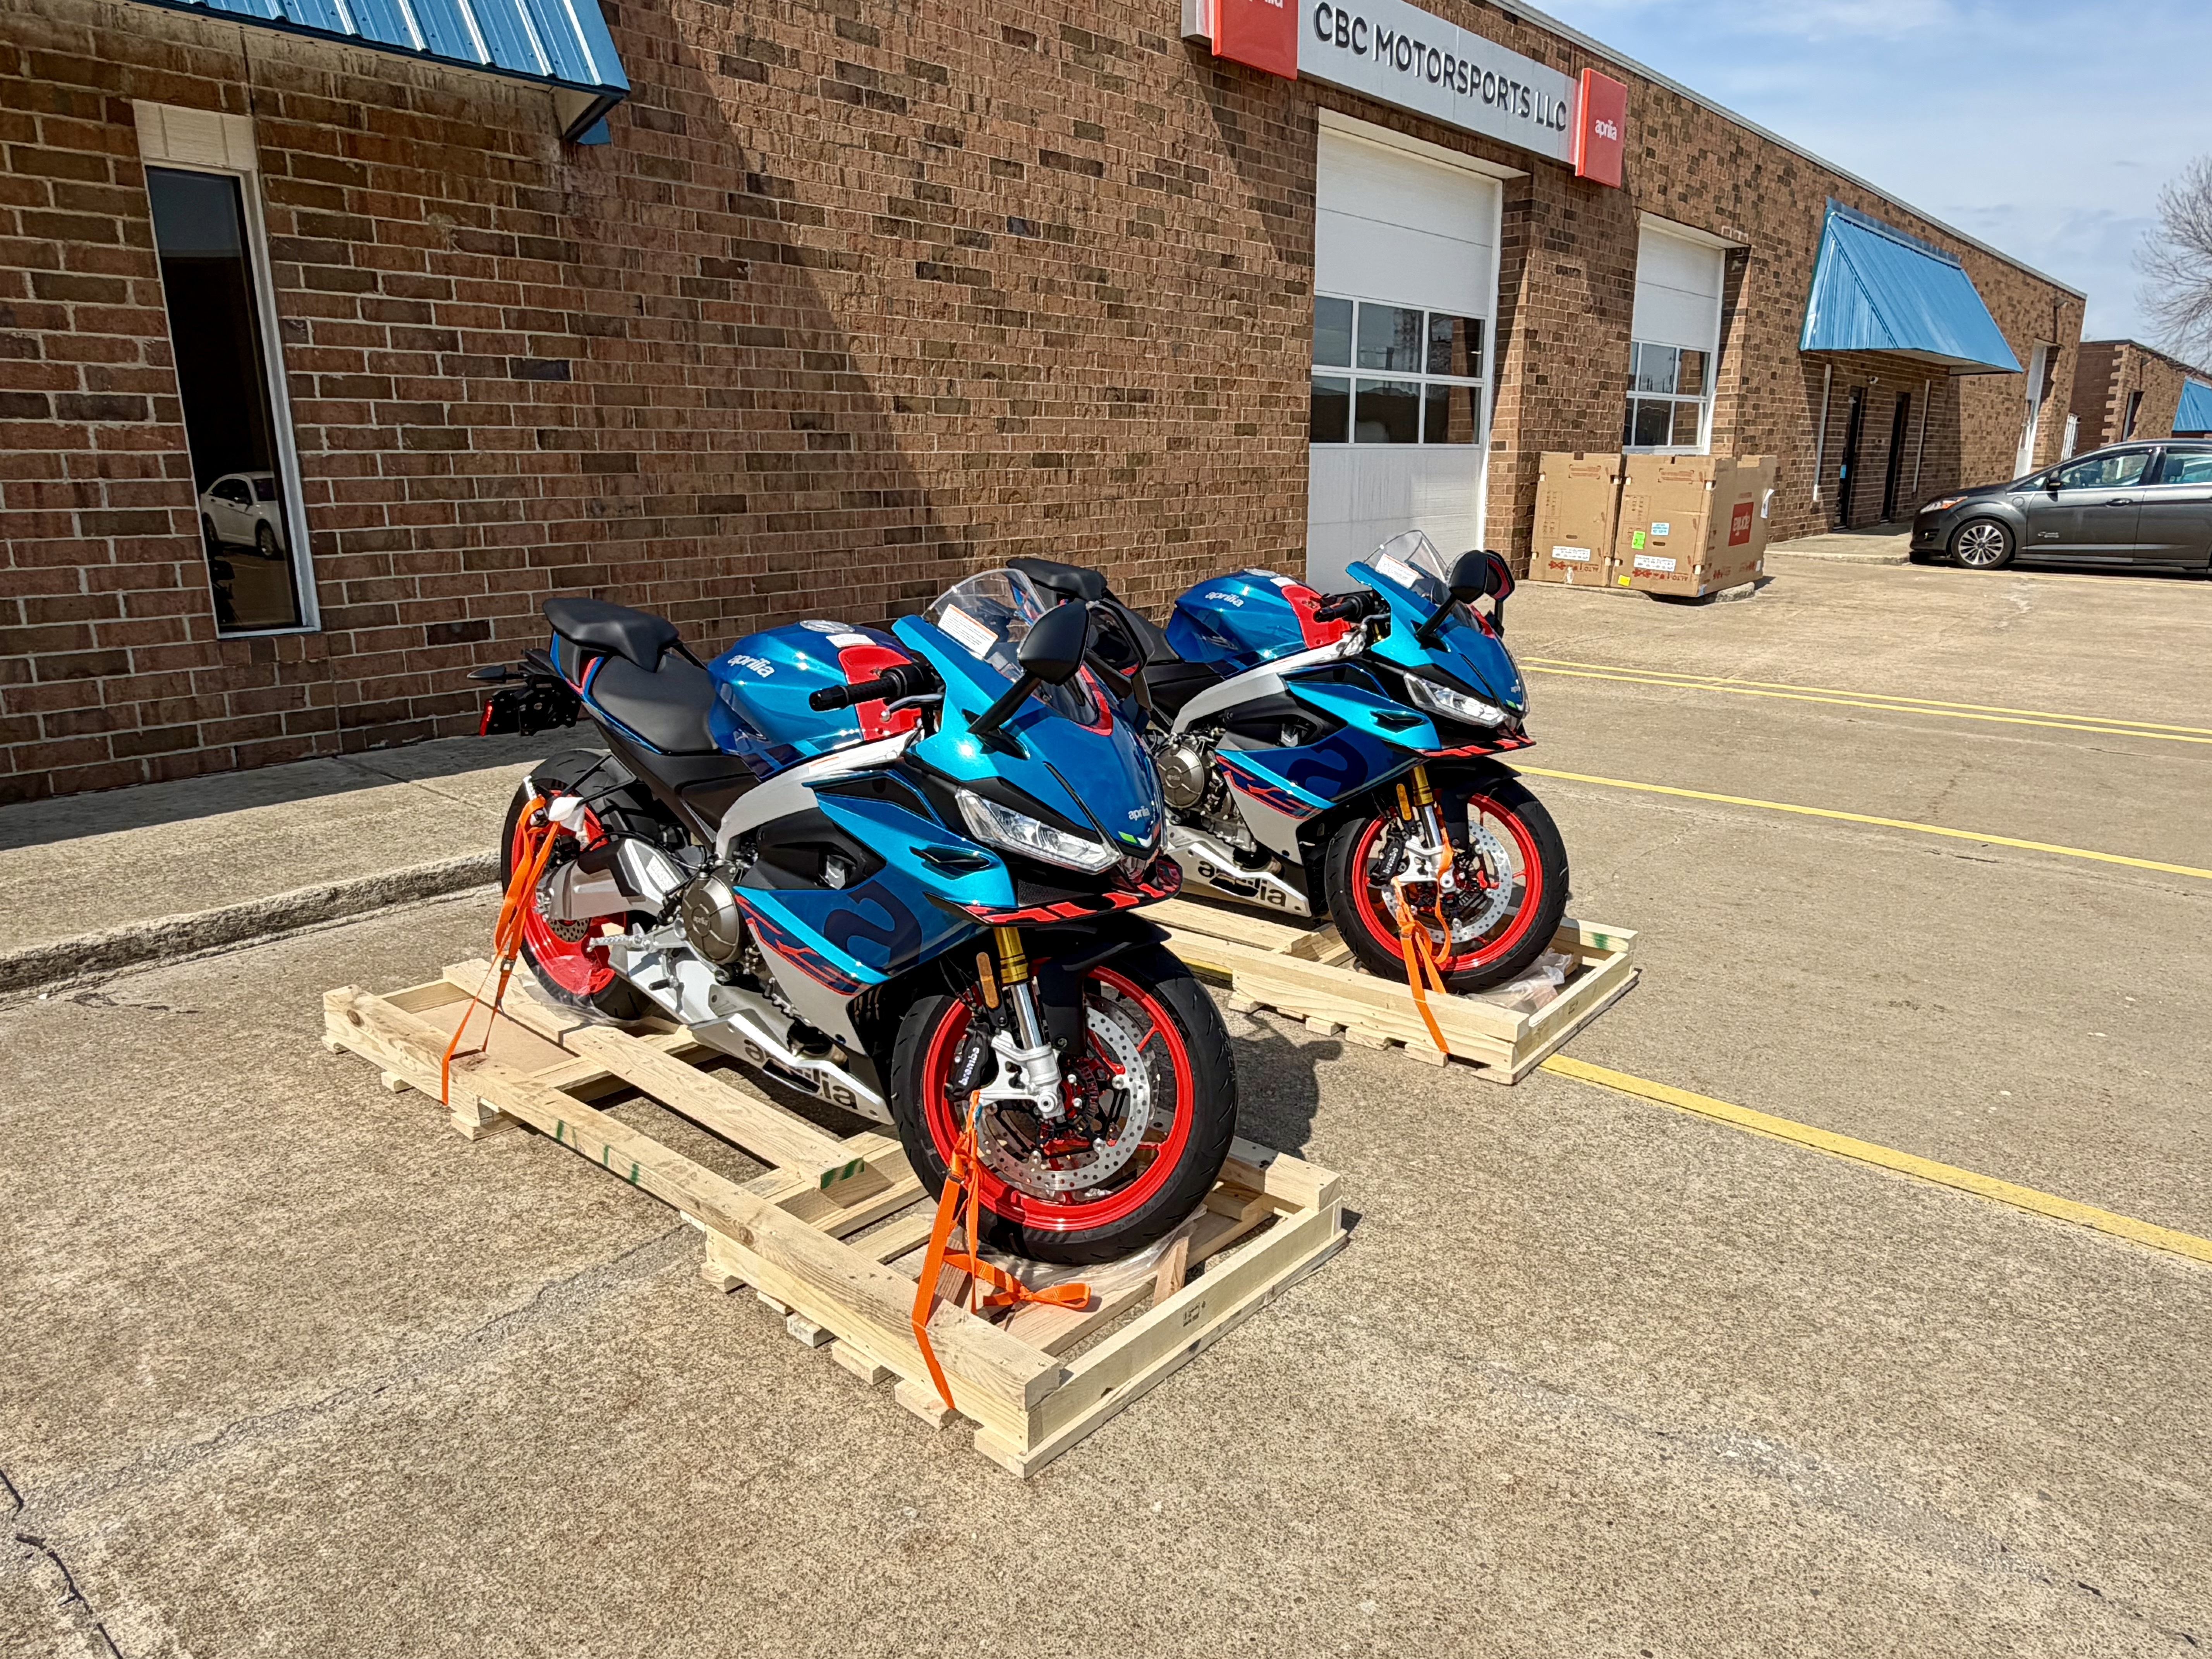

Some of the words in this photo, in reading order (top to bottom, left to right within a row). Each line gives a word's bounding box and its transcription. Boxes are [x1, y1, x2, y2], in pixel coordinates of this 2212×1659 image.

[1314, 1, 1367, 55] CBC
[1372, 23, 1530, 118] MOTORSPORTS
[1534, 91, 1566, 132] LLC
[1205, 592, 1244, 607] aprilia
[728, 654, 775, 678] aprilia
[958, 1047, 980, 1085] brembo
